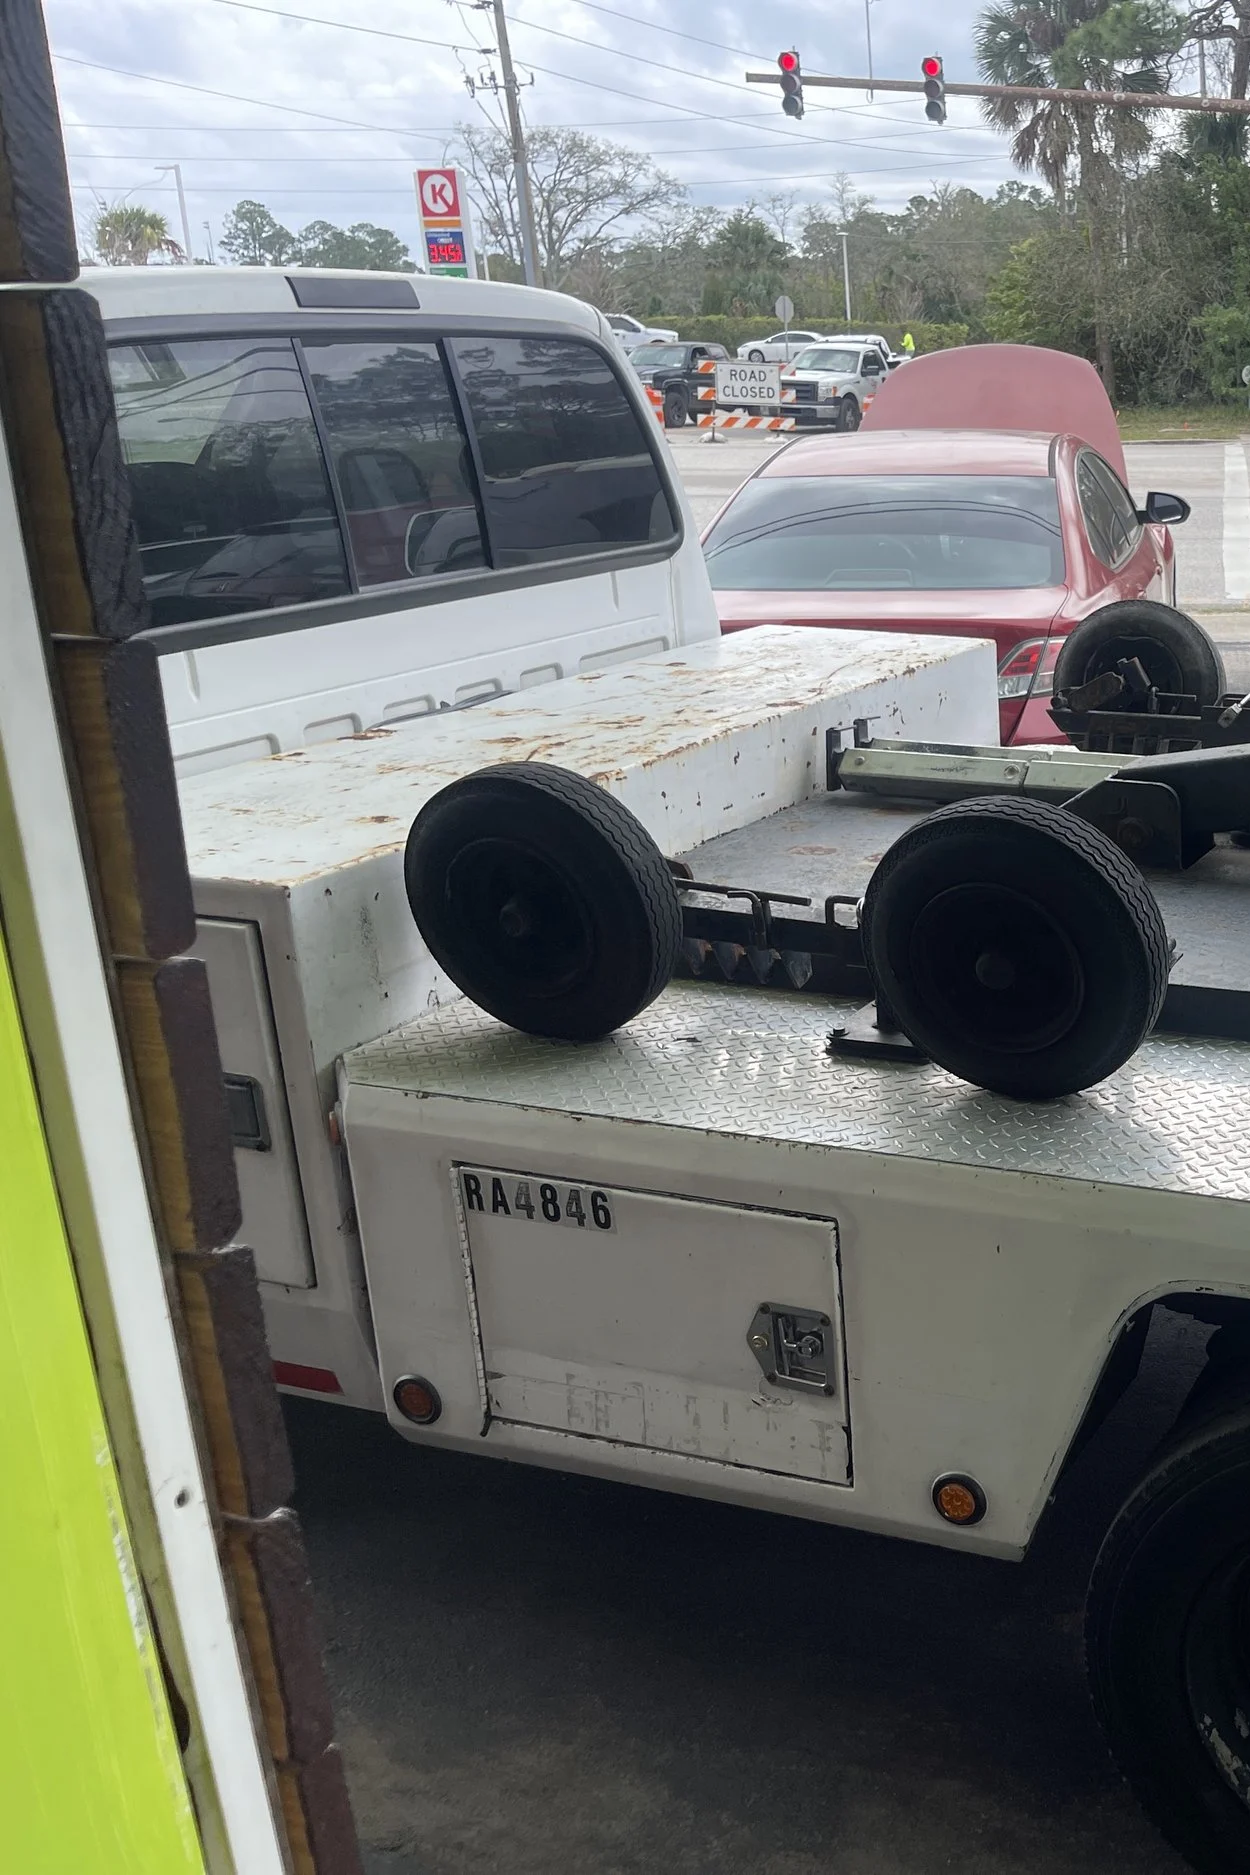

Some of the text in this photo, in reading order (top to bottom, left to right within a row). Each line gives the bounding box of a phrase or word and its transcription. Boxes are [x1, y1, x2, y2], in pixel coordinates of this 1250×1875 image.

[431, 183, 452, 210] K
[729, 369, 767, 382] ROAD
[722, 385, 775, 399] CLOSED
[463, 1173, 612, 1230] RA4846
